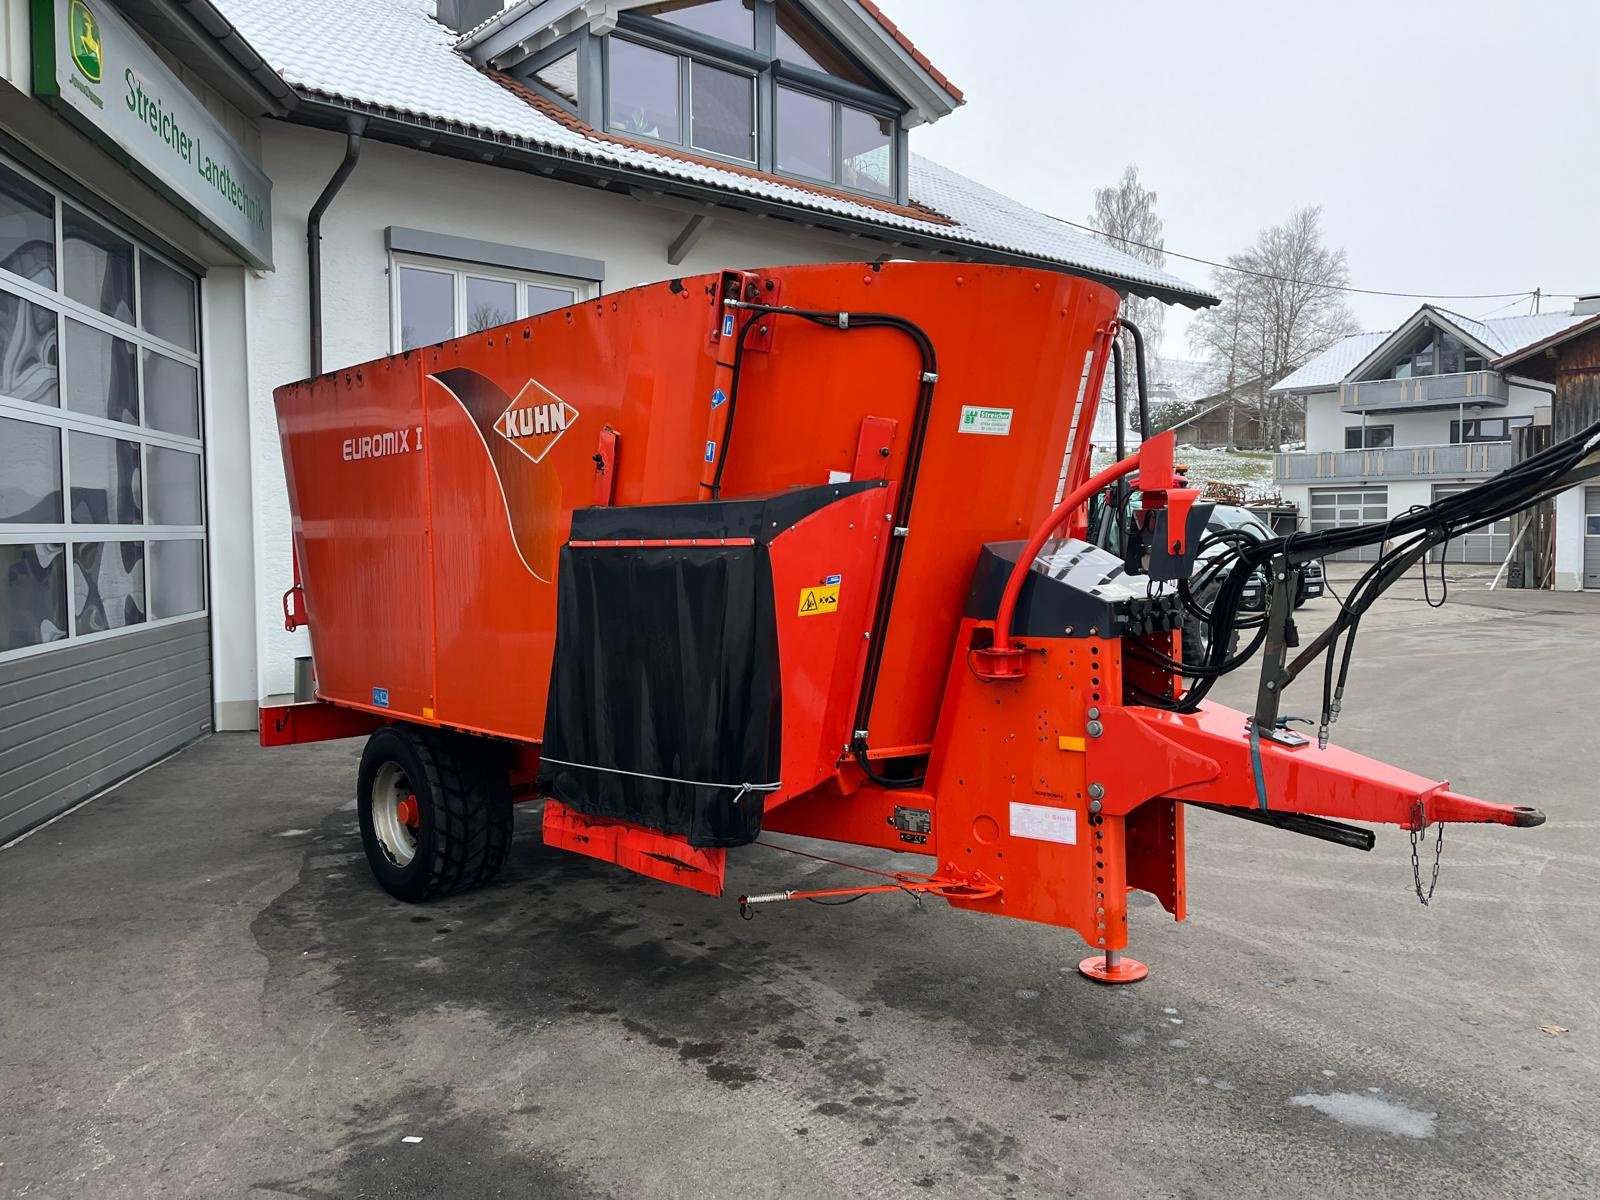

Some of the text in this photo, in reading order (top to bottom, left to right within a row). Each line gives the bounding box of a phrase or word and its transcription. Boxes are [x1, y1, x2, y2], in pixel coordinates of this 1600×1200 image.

[125, 68, 265, 231] Streicher Landtechnik
[505, 401, 566, 438] KUHN
[343, 430, 409, 461] EUROMIX
